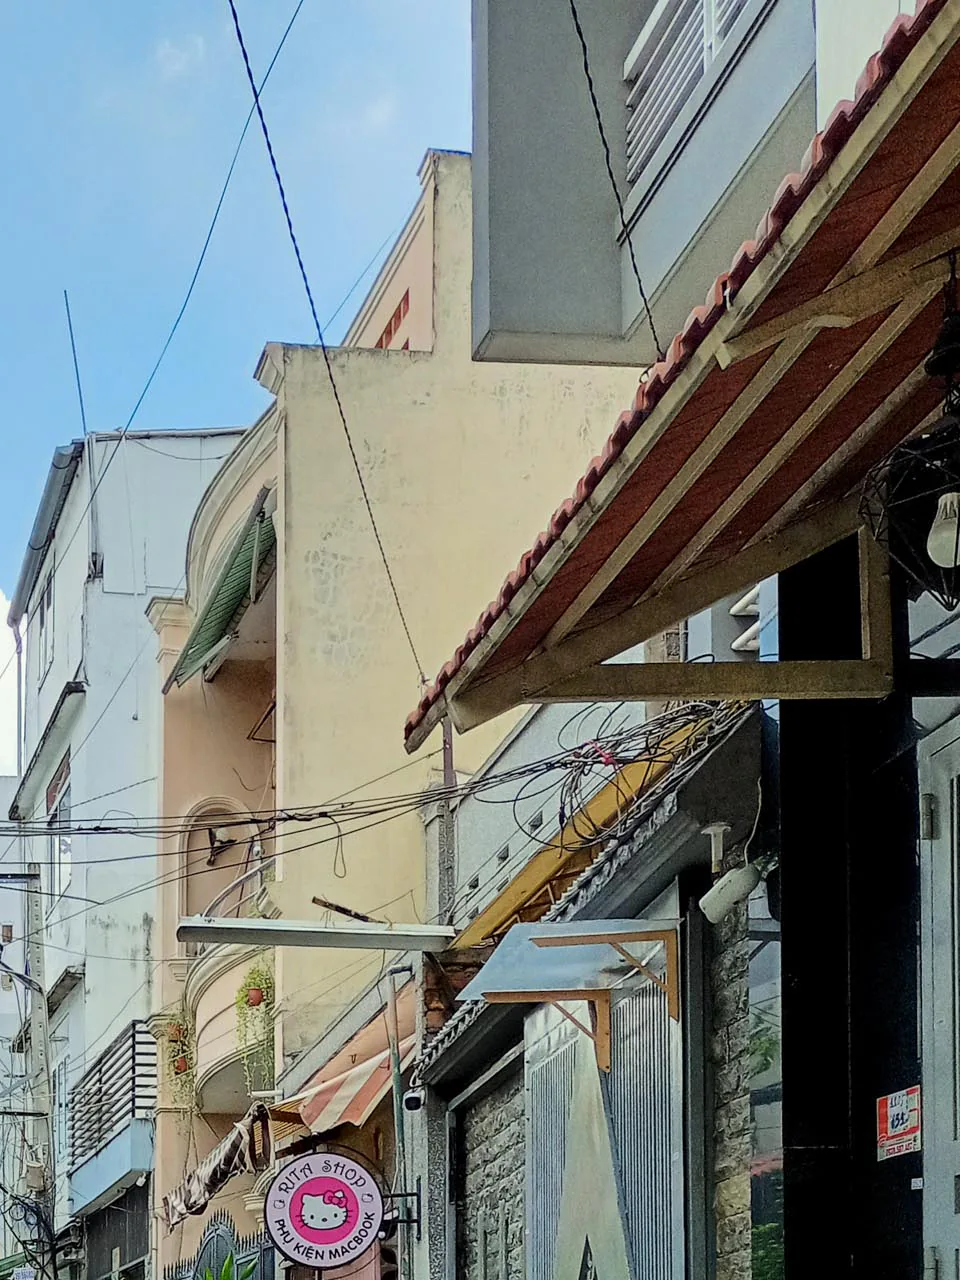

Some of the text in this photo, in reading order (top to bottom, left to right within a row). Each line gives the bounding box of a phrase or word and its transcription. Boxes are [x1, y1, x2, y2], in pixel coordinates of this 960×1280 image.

[278, 1159, 367, 1194] RITA SHOP
[274, 1211, 376, 1261] PHỤ KIỆN MACBOOK
